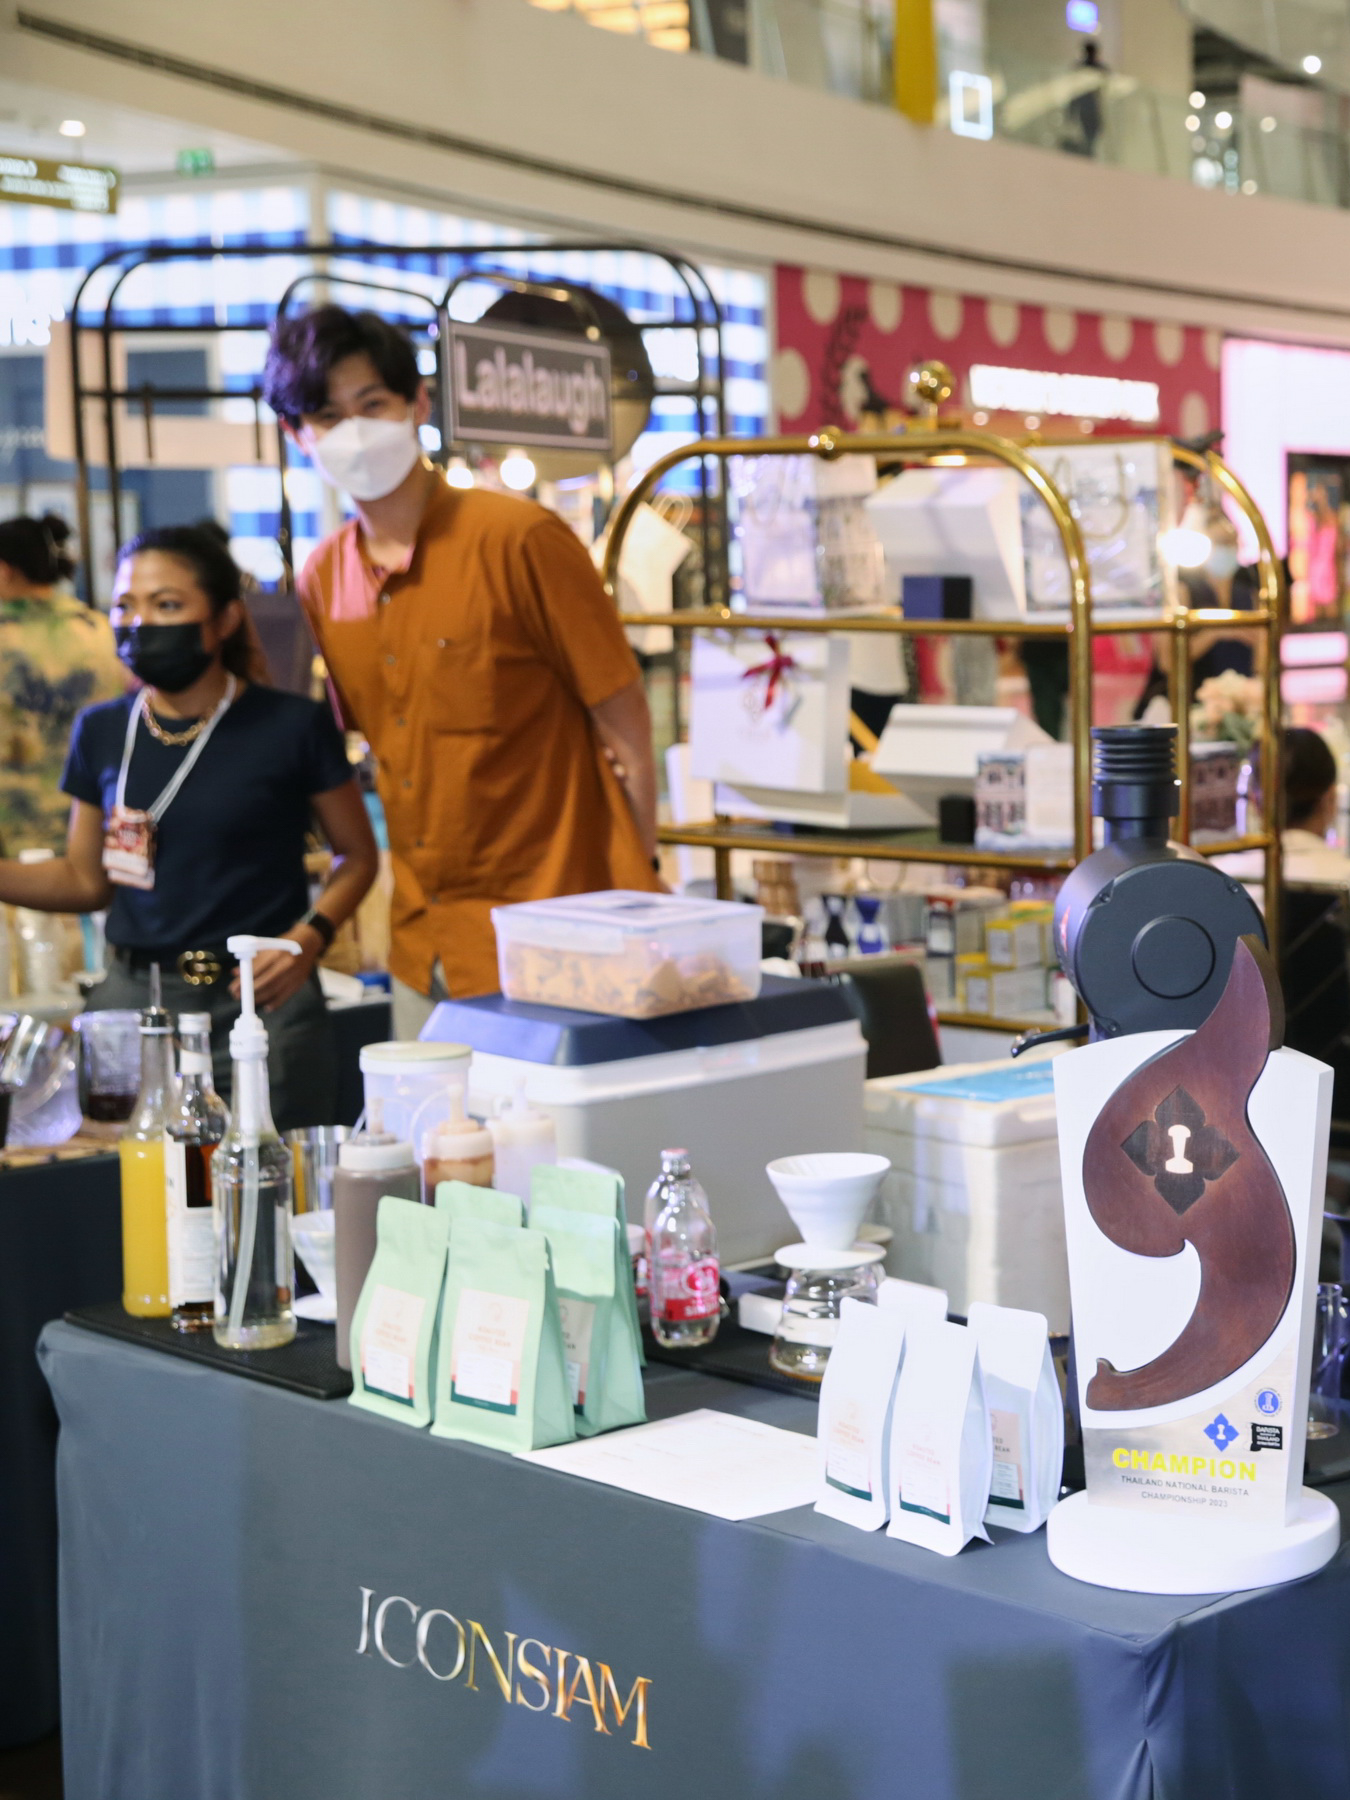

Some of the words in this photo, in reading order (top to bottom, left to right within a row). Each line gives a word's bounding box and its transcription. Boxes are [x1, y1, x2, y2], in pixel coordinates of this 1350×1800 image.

[454, 339, 607, 435] Lalalaugh
[1111, 1447, 1257, 1482] CHAMPION
[1121, 1475, 1164, 1487] THAILAND
[1165, 1480, 1209, 1493] NATIONAL
[1211, 1485, 1250, 1497] BARISTA
[1141, 1491, 1207, 1505] CHAMPIONSHIP
[1209, 1497, 1228, 1508] 2023
[355, 1585, 653, 1751] ICONSIAM
